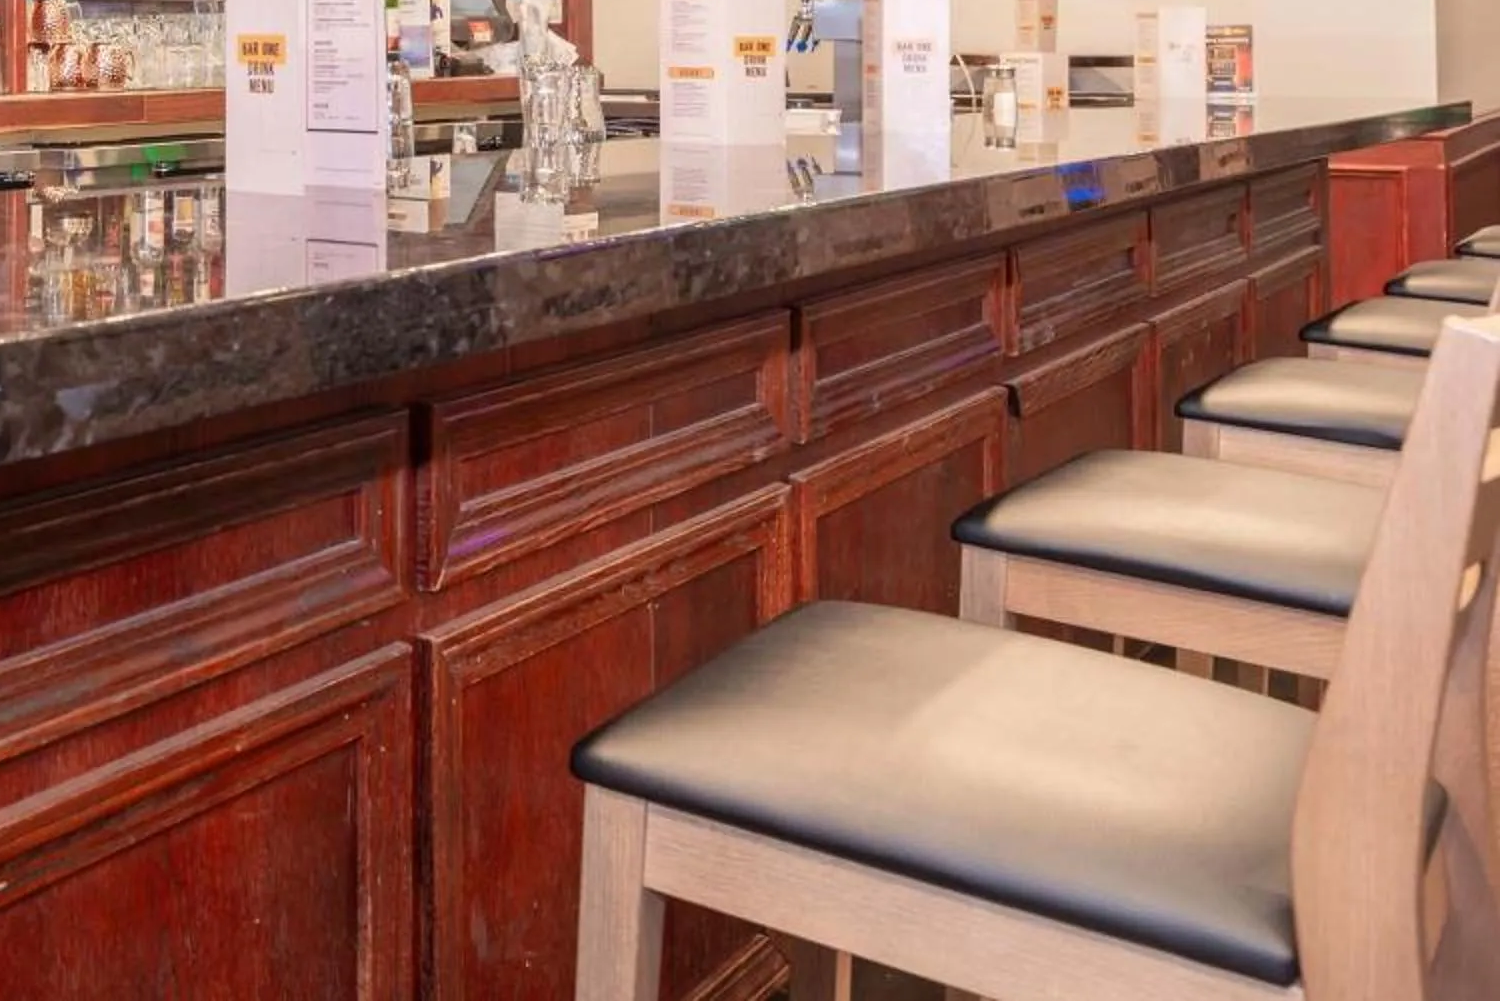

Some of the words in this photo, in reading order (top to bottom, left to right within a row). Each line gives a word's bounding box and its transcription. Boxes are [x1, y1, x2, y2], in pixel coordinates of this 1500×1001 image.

[242, 42, 258, 55] BAR
[262, 42, 279, 56] ONE
[249, 78, 274, 93] MENU
